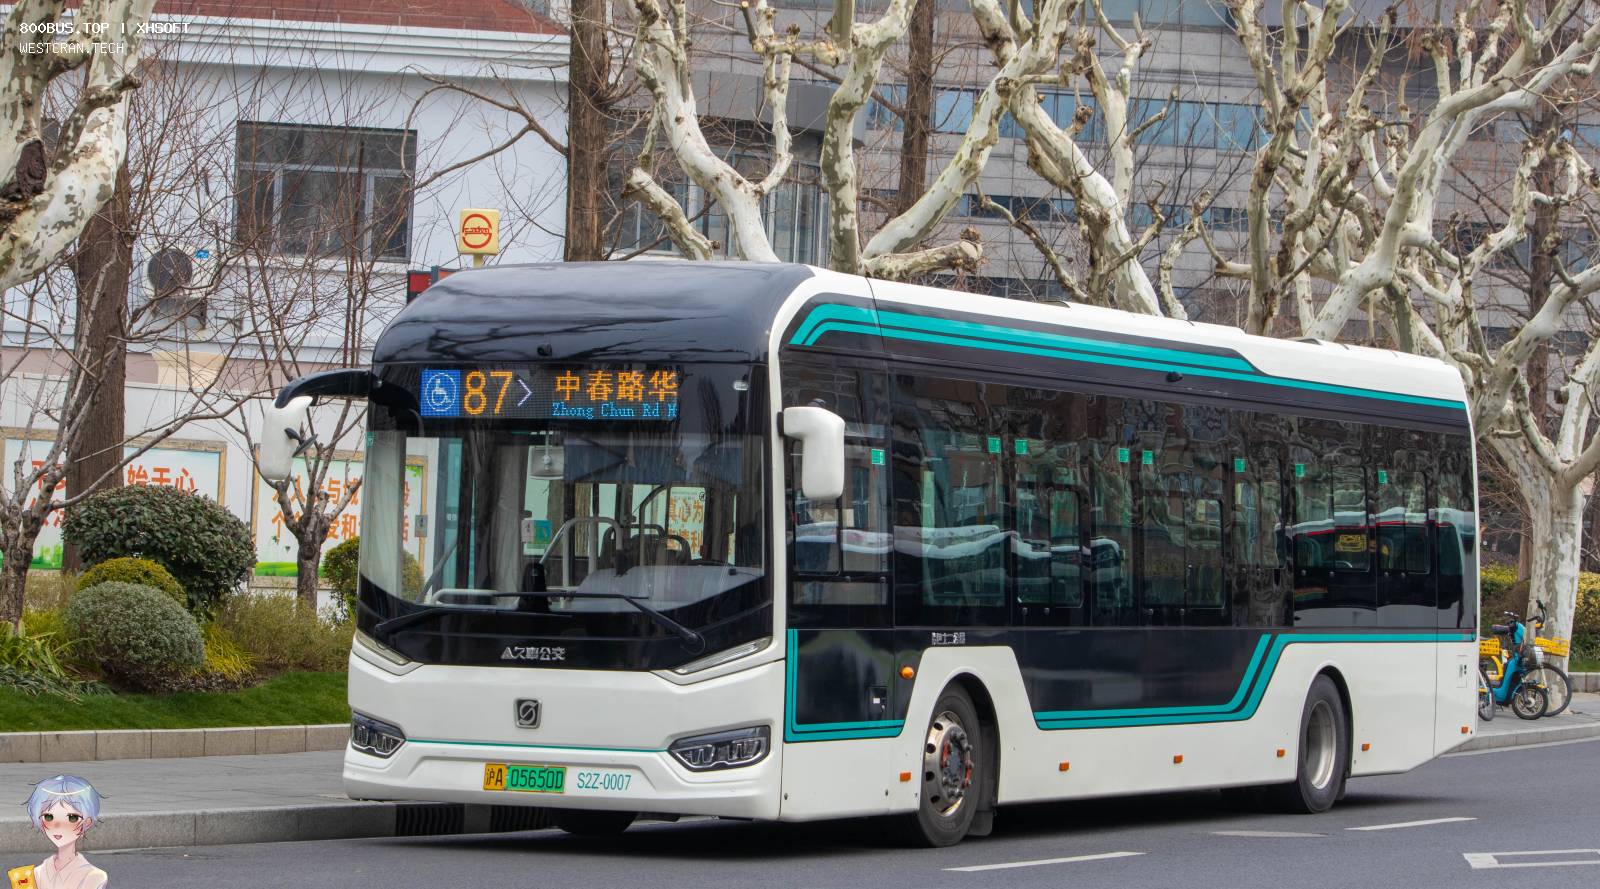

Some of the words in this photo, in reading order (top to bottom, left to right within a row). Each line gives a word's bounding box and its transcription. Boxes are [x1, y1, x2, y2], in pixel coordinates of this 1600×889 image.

[463, 371, 513, 415] 87
[555, 370, 678, 401] 中春路华
[552, 403, 594, 419] Zhong
[601, 403, 635, 417] Chun
[643, 403, 660, 417] Rd
[510, 768, 565, 790] 05650D
[576, 772, 632, 791] S2Z-0007
